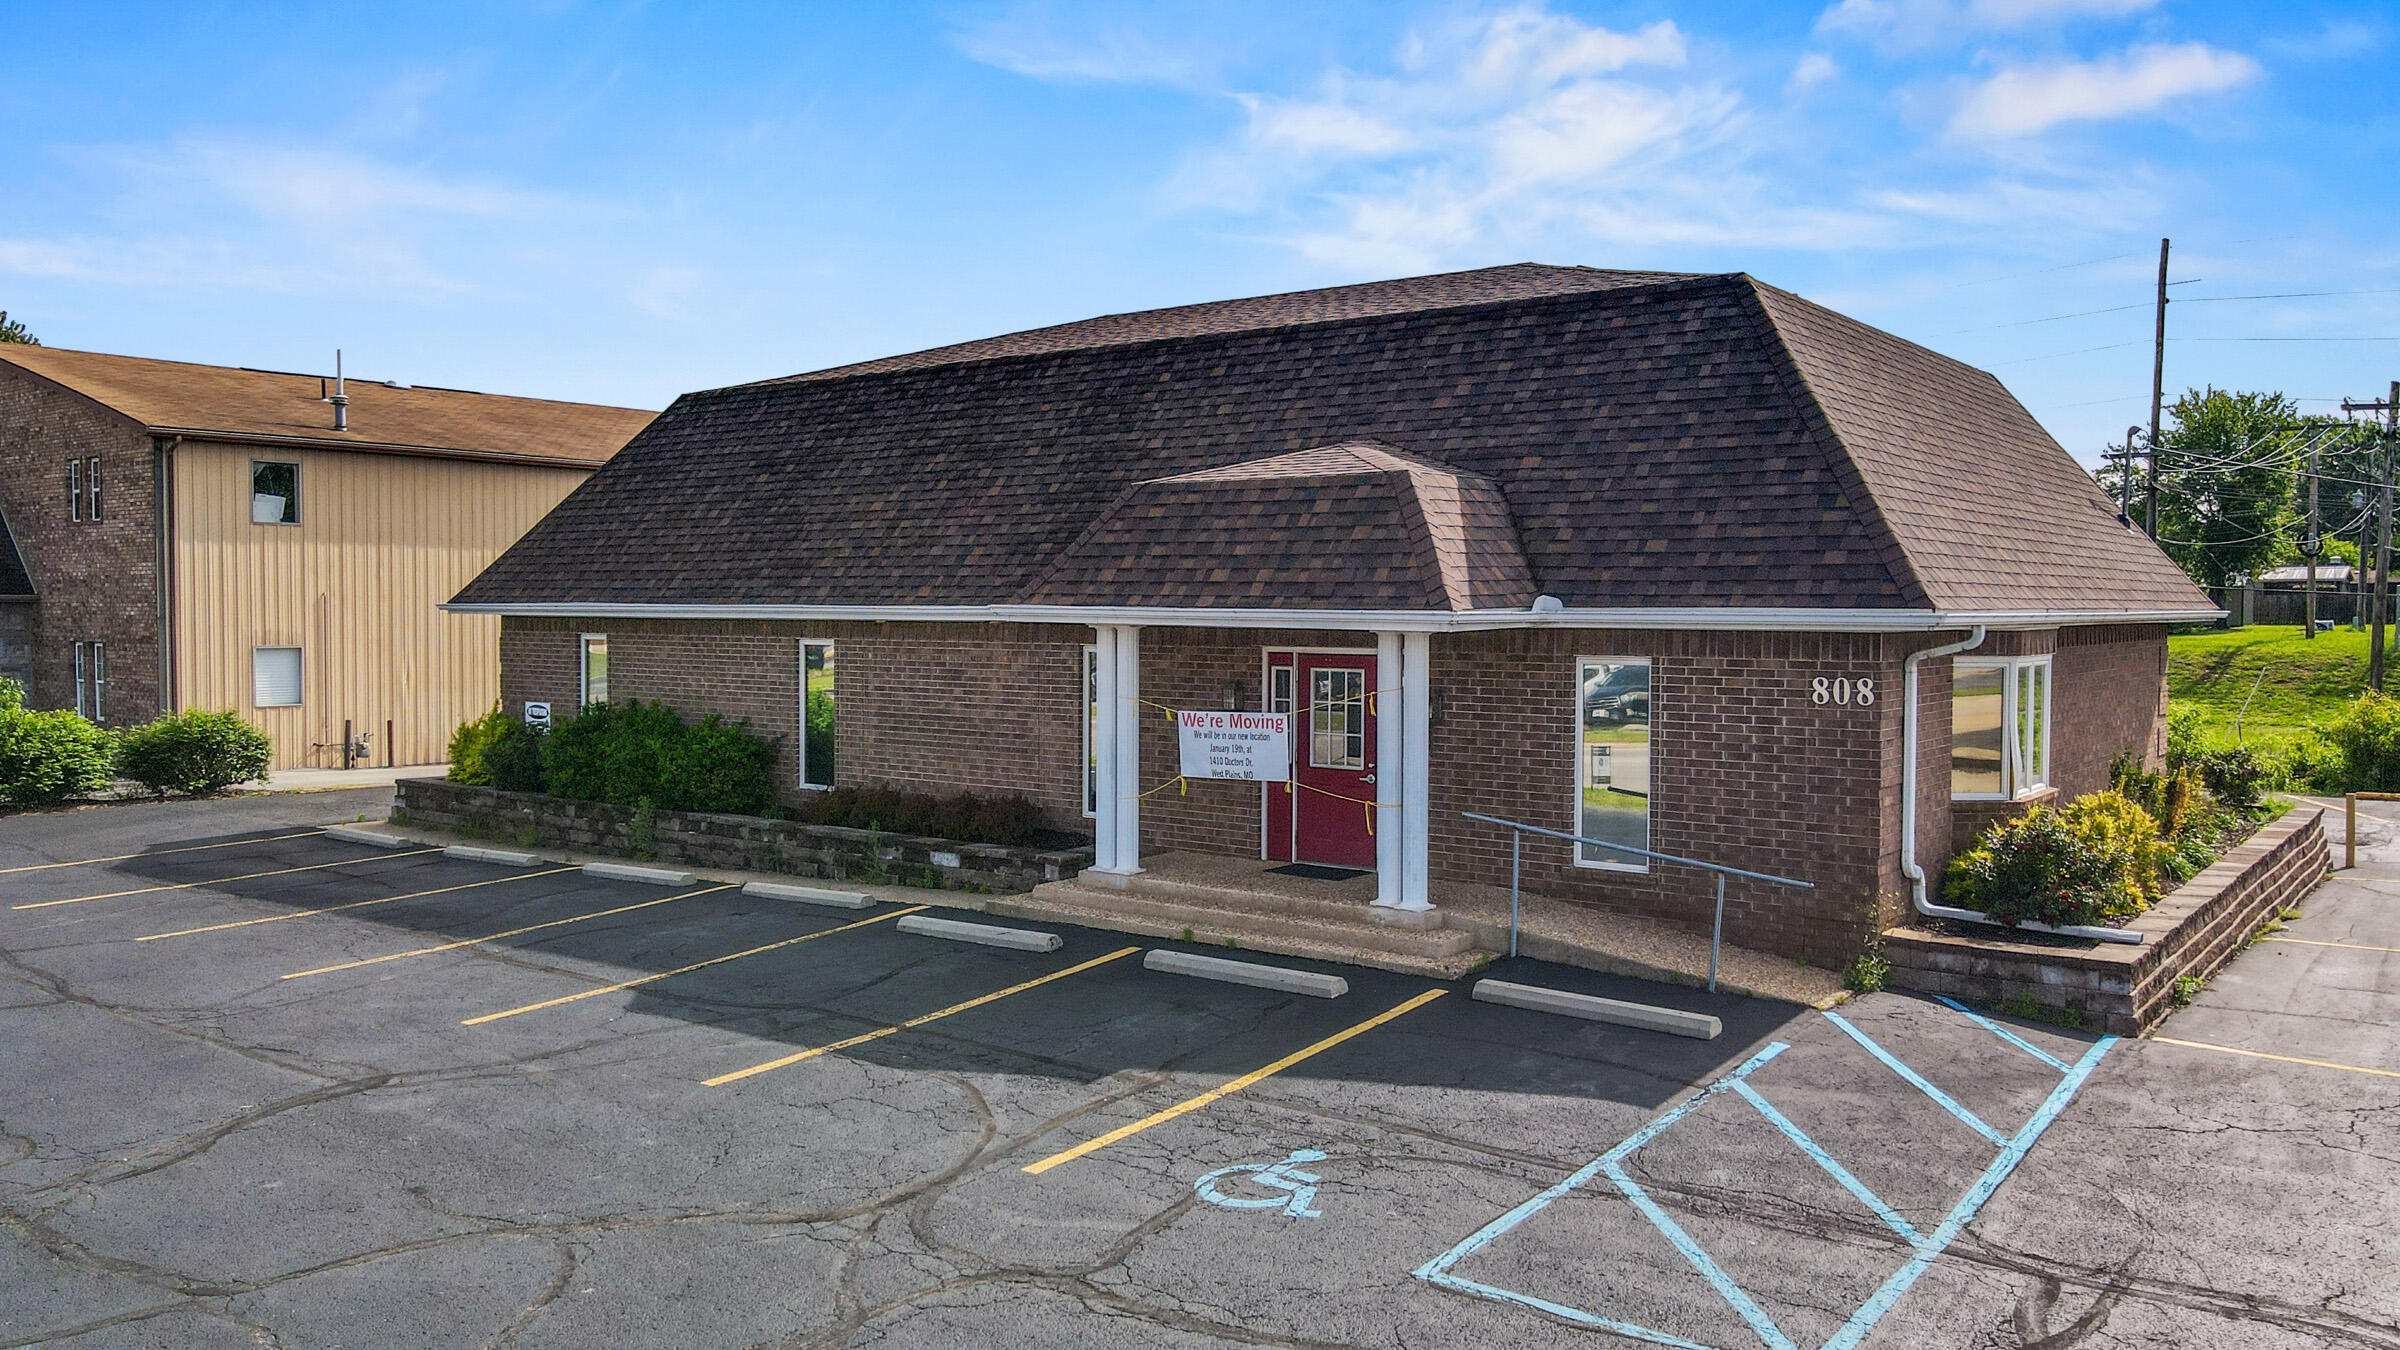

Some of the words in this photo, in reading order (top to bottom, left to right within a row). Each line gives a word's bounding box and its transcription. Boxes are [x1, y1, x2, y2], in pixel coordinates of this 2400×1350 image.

[1811, 676, 1875, 706] 808
[1181, 712, 1224, 728] We're
[1229, 713, 1284, 734] Moving
[1193, 730, 1202, 739] We
[1203, 730, 1212, 739] will
[1213, 731, 1221, 740] be
[1221, 731, 1227, 740] in
[1249, 732, 1271, 741] location
[1209, 743, 1229, 754] January
[1231, 744, 1245, 754] 19th,
[1246, 745, 1252, 753] at
[1209, 756, 1224, 766] 1410
[1224, 757, 1244, 766] Doctors
[1211, 769, 1224, 778] West
[1243, 770, 1254, 779] MO
